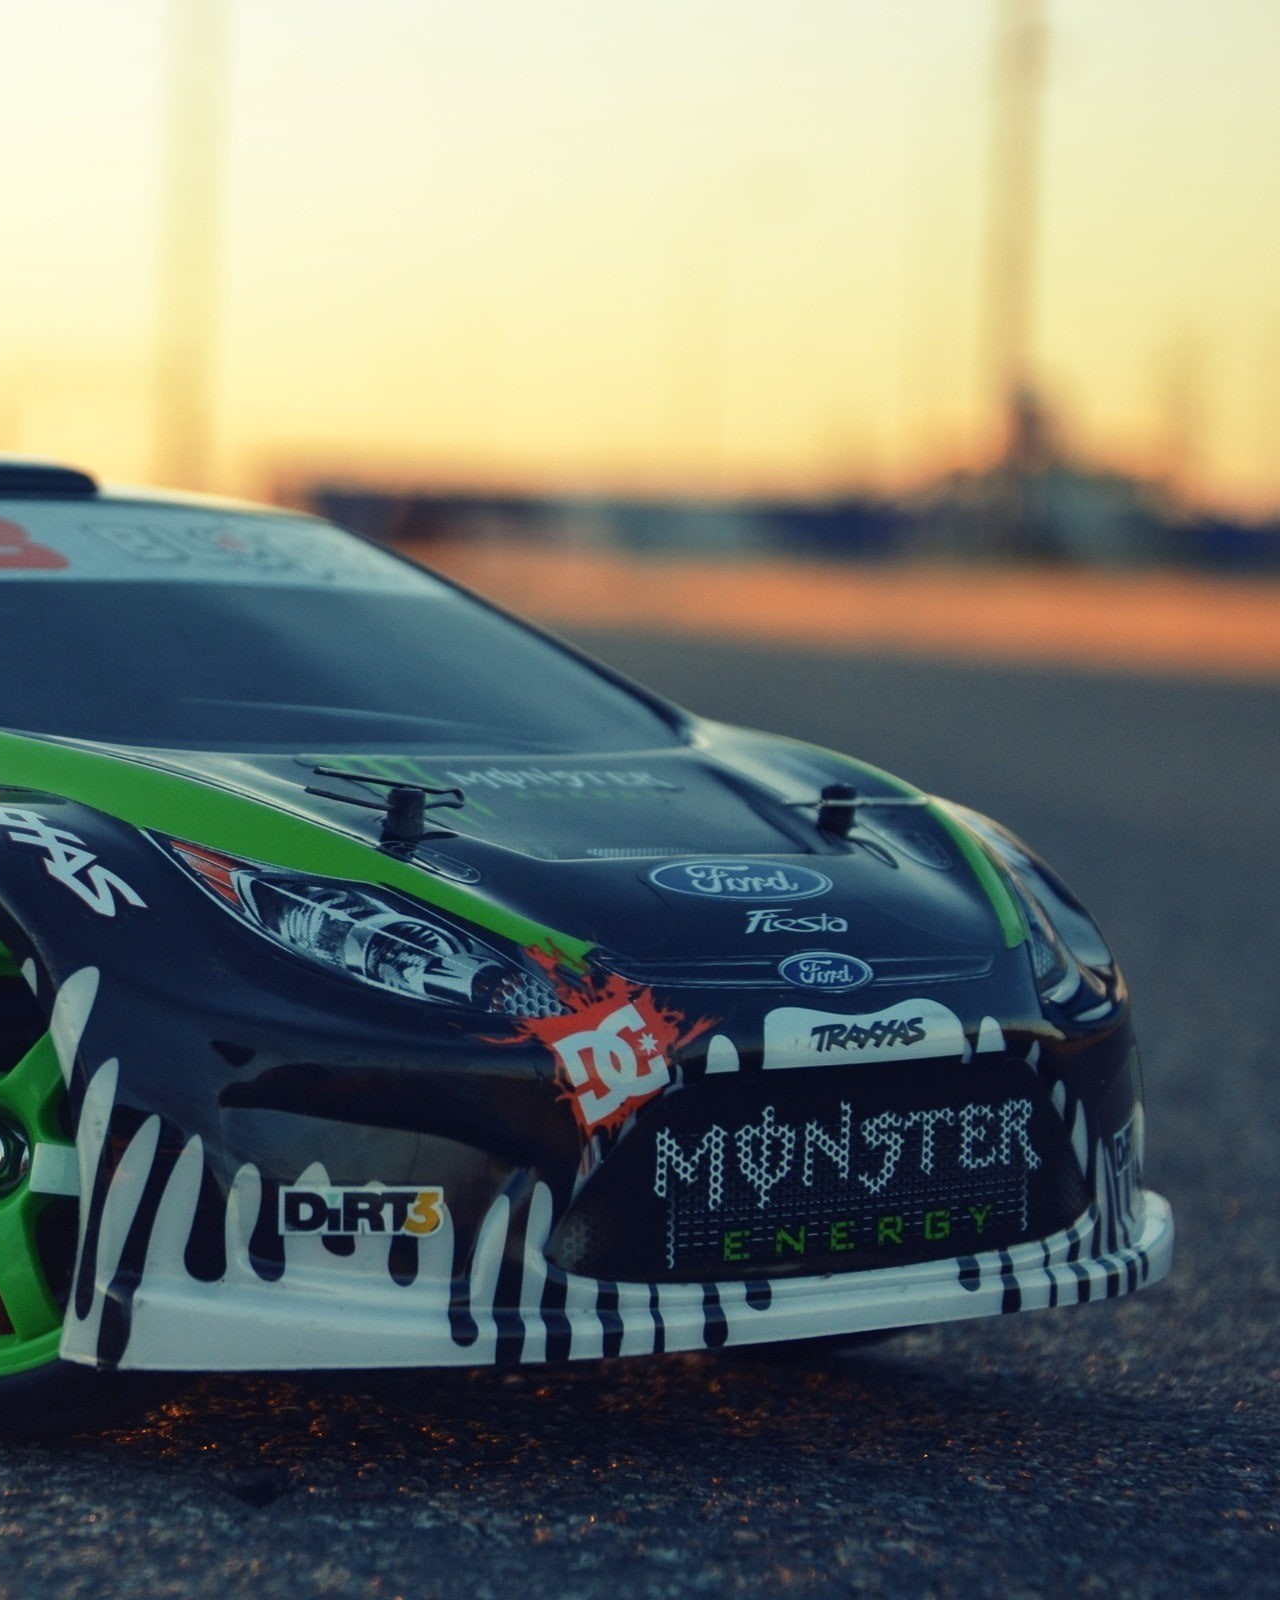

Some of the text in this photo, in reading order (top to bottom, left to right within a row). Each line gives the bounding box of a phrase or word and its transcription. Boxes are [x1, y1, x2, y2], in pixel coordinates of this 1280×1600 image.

[686, 865, 798, 893] Ford
[745, 908, 848, 934] Fiesta
[799, 959, 854, 984] Ford
[811, 1016, 926, 1053] TRAXXAS
[552, 1003, 670, 1125] DC
[654, 1099, 1042, 1211] MONSTER
[724, 1205, 992, 1261] ENERGY
